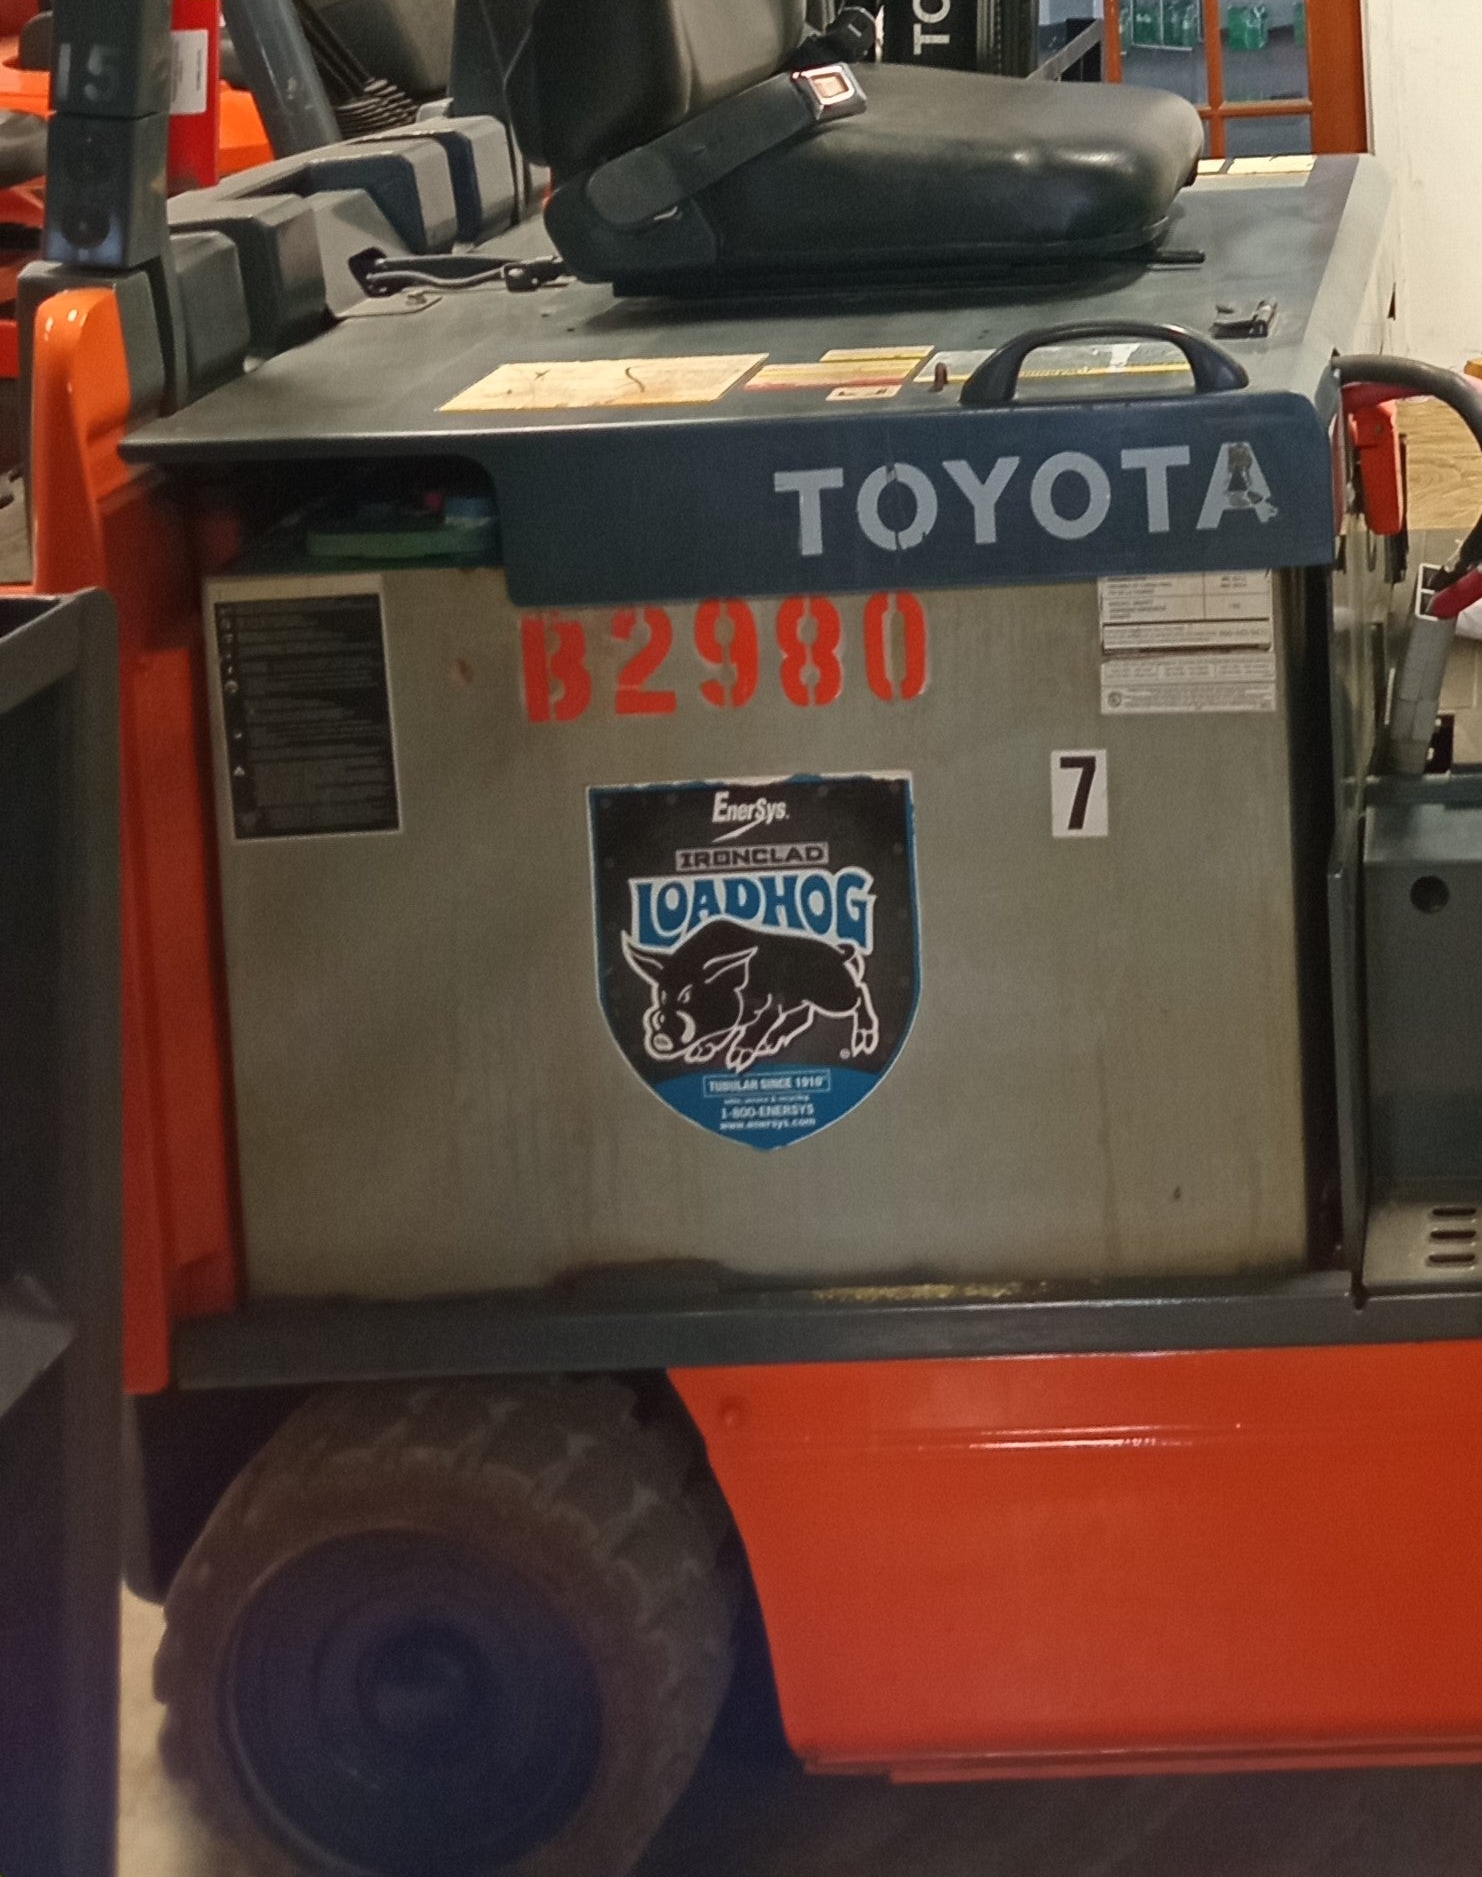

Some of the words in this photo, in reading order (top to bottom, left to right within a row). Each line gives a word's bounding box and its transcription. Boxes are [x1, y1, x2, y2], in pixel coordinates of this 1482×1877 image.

[774, 442, 1278, 556] TOYOTA
[520, 591, 929, 723] B2980
[1059, 756, 1097, 830] 7
[680, 845, 824, 868] IRONCLAD
[632, 869, 873, 953] LOADHOG
